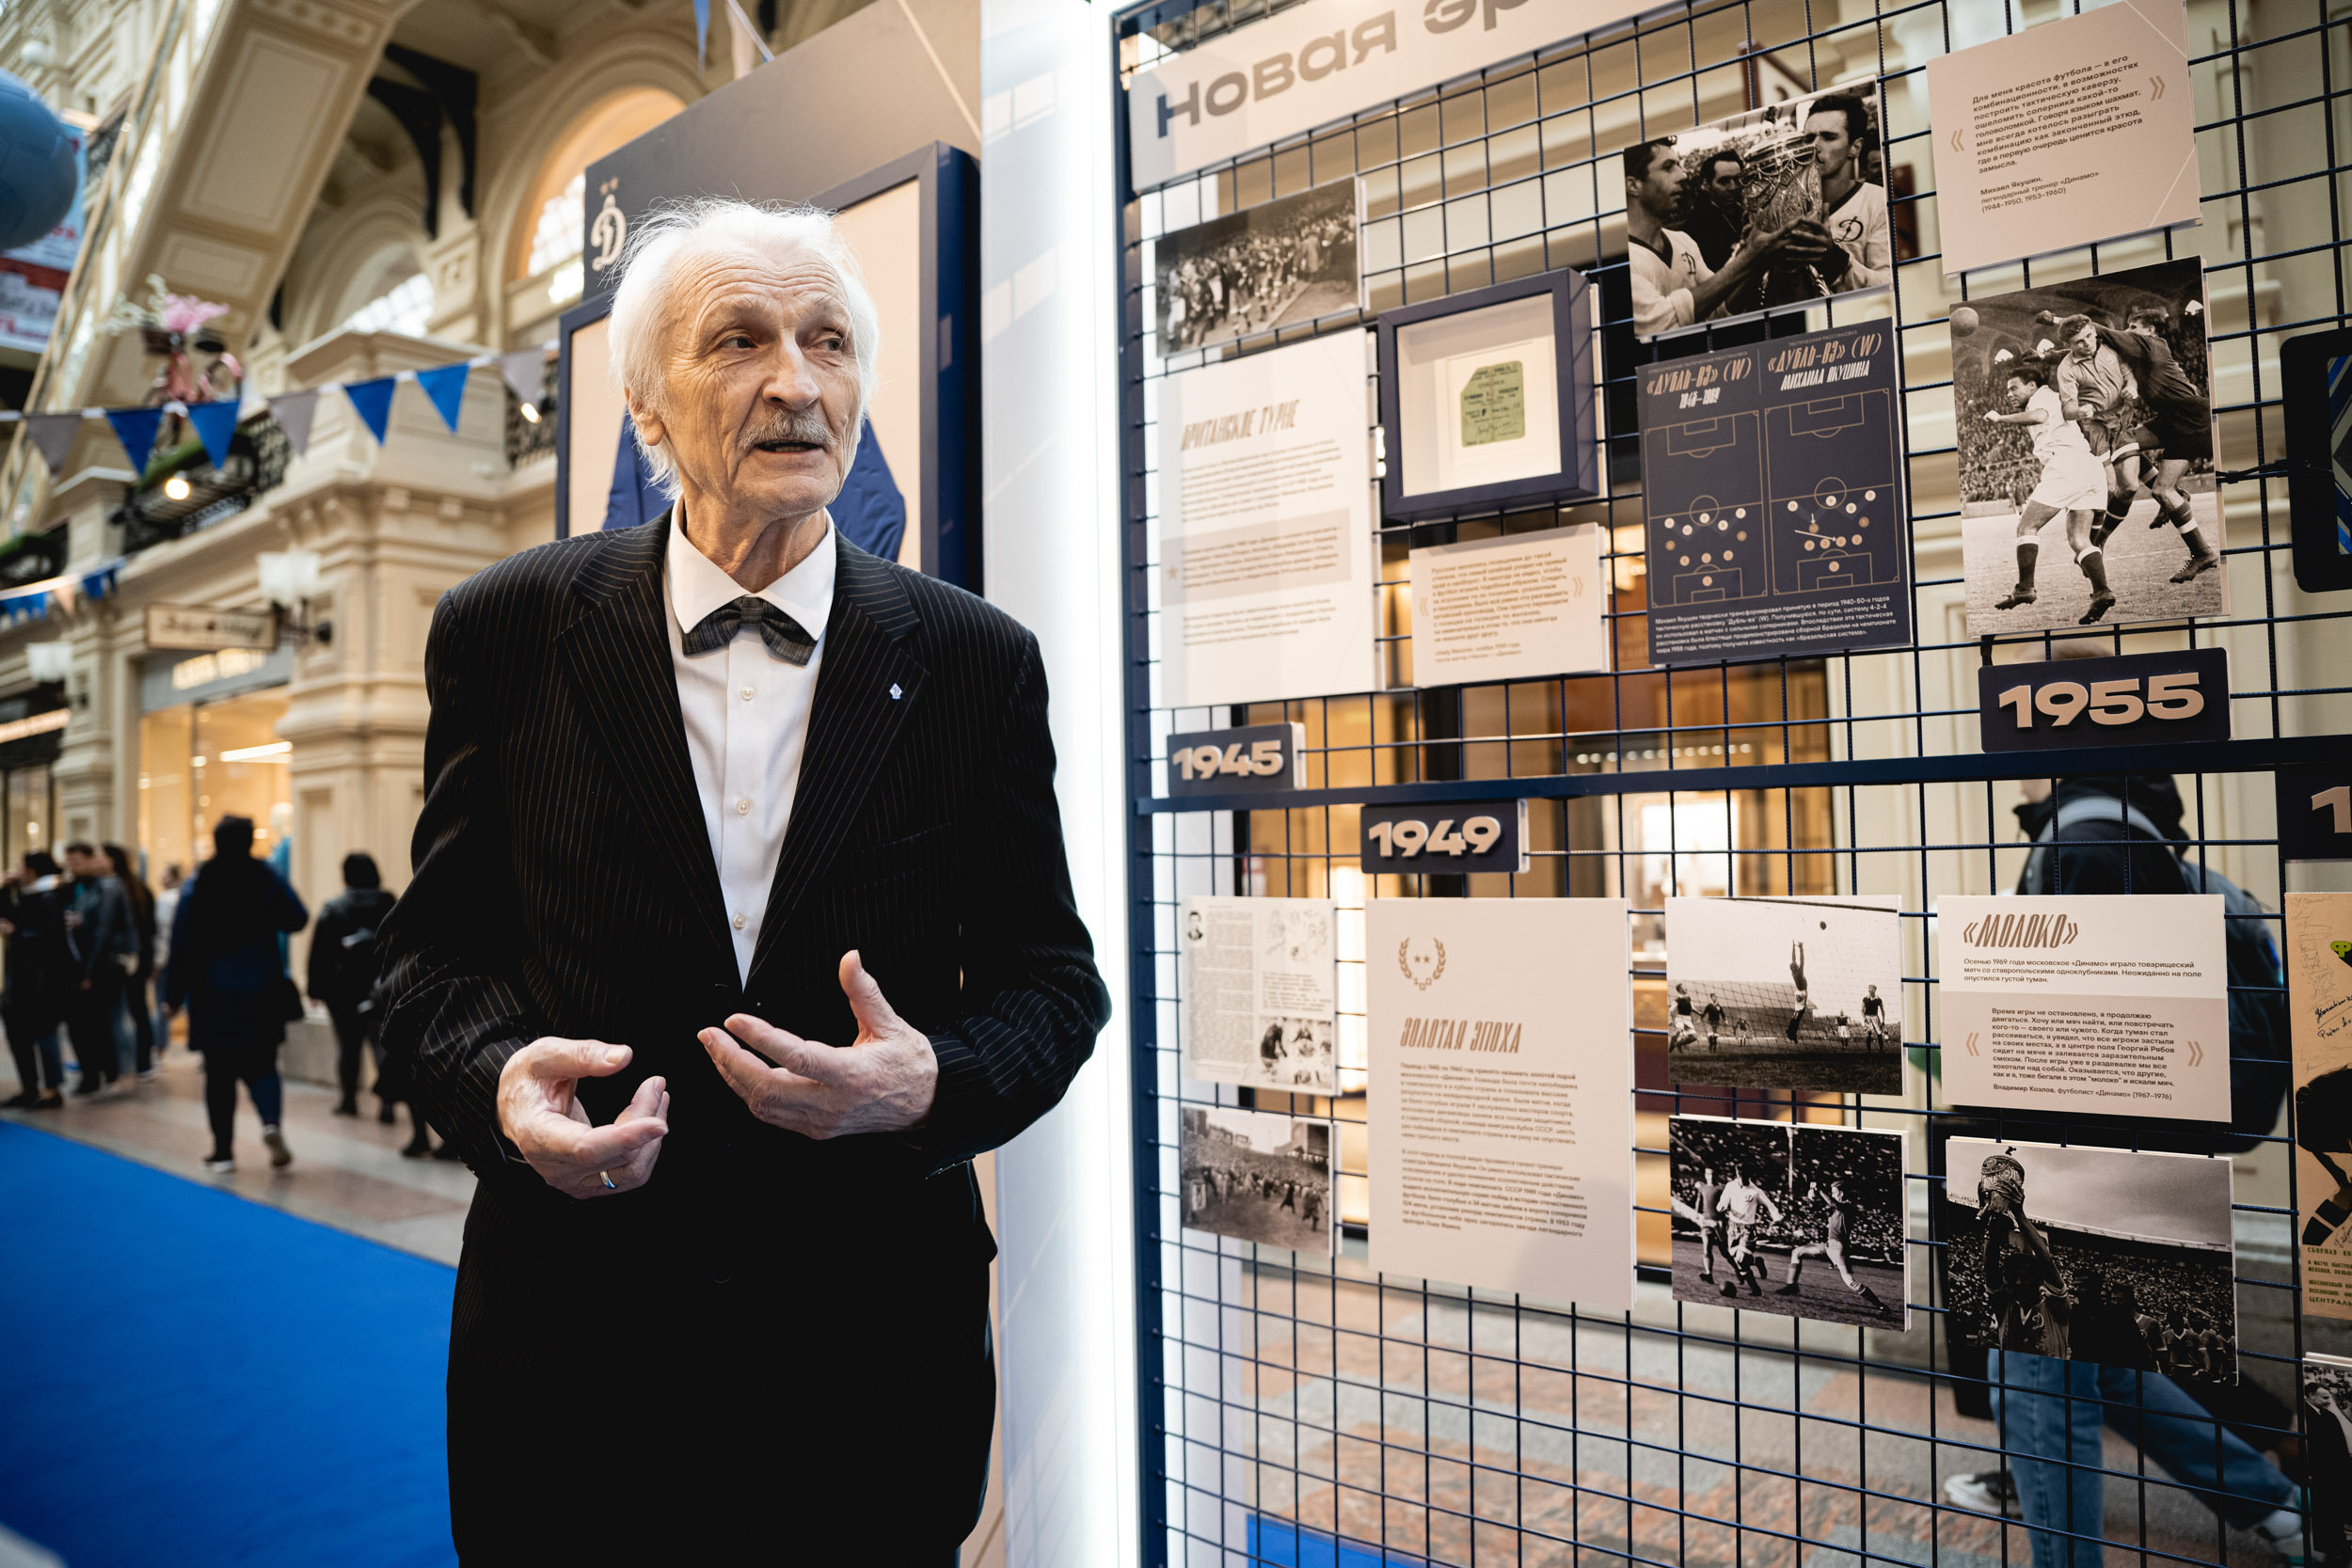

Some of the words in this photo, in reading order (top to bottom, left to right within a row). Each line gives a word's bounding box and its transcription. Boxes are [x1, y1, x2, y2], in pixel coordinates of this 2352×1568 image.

[1423, 0, 1530, 34] эр
[1972, 94, 1989, 104] Для
[1991, 87, 2012, 98] меня
[2014, 77, 2051, 91] красота
[2053, 65, 2091, 82] футбола
[2111, 55, 2128, 64] его
[1973, 84, 2061, 112] комбинационности,
[2070, 61, 2138, 86] возможностях
[1974, 104, 2019, 120] построить
[2021, 87, 2079, 107] тактическую
[2081, 76, 2122, 91] каверзу,
[1975, 113, 2024, 130] ошеломить
[2026, 98, 2074, 116] соперника
[2076, 87, 2119, 103] какой-то
[1975, 117, 2037, 138] головоломкой.
[2038, 109, 2068, 121] Говоря
[2070, 100, 2103, 113] языком
[2105, 89, 2142, 104] шахмат,
[1976, 138, 1993, 147] мне
[1995, 130, 2025, 142] всегда
[2026, 119, 2069, 134] хотелось
[2071, 105, 2120, 123] разыграть
[1977, 137, 2032, 156] комбинацию
[2034, 133, 2049, 141] как
[2051, 115, 2112, 136] законченный
[2114, 109, 2141, 120] этюд,
[1999, 147, 2030, 159] первую
[2031, 137, 2068, 150] очередь
[2069, 127, 2105, 141] ценится
[2106, 118, 2142, 132] красота
[1979, 160, 2018, 173] замысла.
[1979, 183, 2010, 196] Михаил
[2010, 176, 2043, 188] Якушин,
[1980, 186, 2029, 204] легендарный
[2031, 181, 2058, 192] тренер
[2059, 171, 2099, 184] «Динамо»
[1981, 197, 2024, 214] (1944–1950,
[2025, 186, 2066, 201] 1953–1960)
[1724, 356, 1752, 383] (W)
[1768, 341, 1846, 373] «ДУБЛЬ-ВЭ»
[1851, 332, 1882, 358] (W)
[1780, 368, 1825, 391] МИХАИЛА
[1826, 360, 1870, 383] ЯКУШИНА
[1259, 399, 1300, 435] ТУРНЕ
[1998, 672, 2204, 728] 1955
[1172, 739, 1284, 781] 1945
[2311, 785, 2352, 833] 1
[1368, 816, 1502, 857] 1949
[1963, 913, 2078, 948] «МОЛОКО»
[1400, 1017, 1468, 1050] ЗОЛОТАЯ
[1470, 1020, 1522, 1053] ЭПОХА
[2117, 1044, 2148, 1053] Георгий
[2024, 1055, 2047, 1064] После
[2068, 1066, 2121, 1075] Оказывается,
[2101, 1053, 2164, 1061] заразительным
[1993, 1083, 2027, 1092] Владимир
[2132, 1091, 2171, 1101] (1967–1976)
[2309, 1296, 2352, 1307] ЦЕНТРАЛЬ
